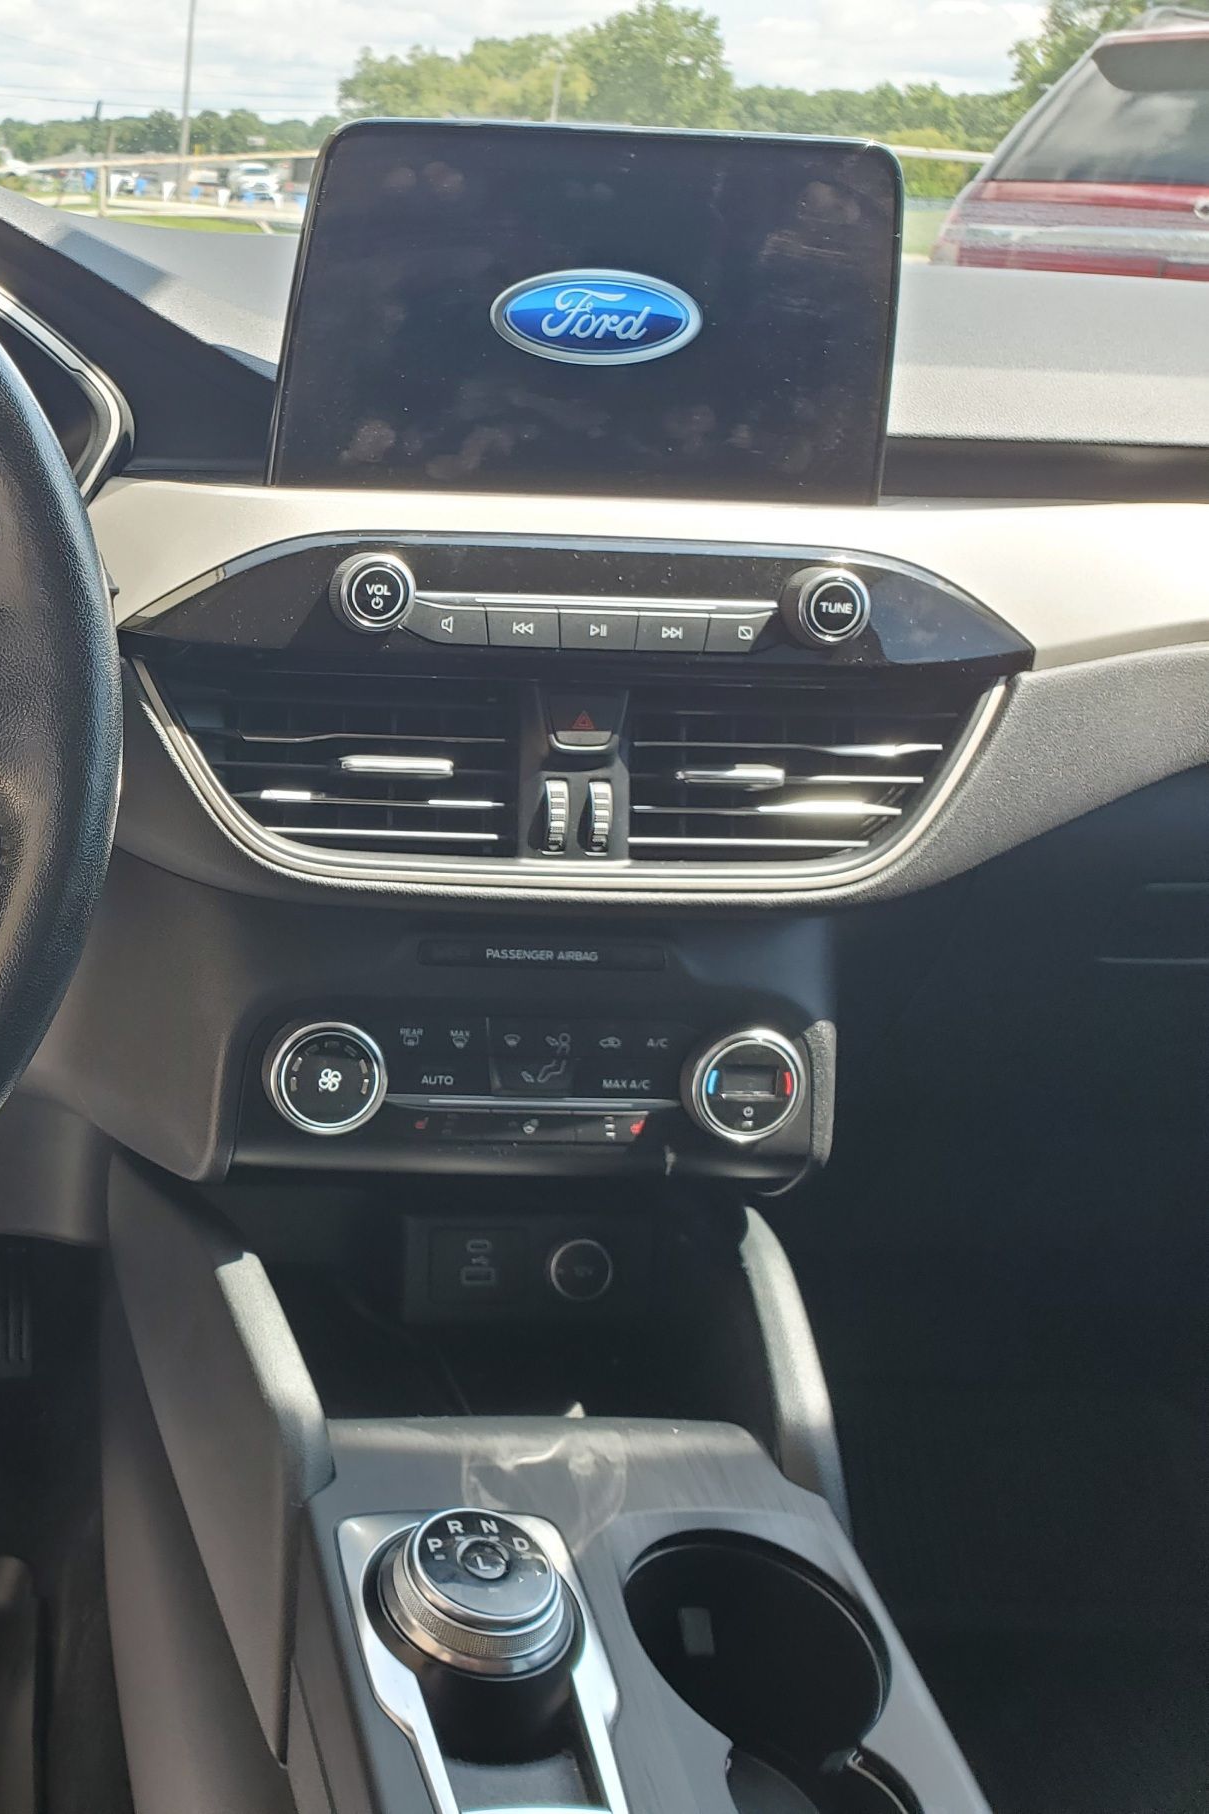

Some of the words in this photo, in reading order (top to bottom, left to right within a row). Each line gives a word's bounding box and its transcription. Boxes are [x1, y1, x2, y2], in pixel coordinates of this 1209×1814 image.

[540, 288, 652, 341] Ford
[365, 583, 391, 596] VOL
[819, 601, 853, 616] TUNE
[485, 948, 554, 960] PASSENGER
[557, 950, 599, 962] AIRBAG
[399, 1027, 424, 1037] REAR
[449, 1029, 471, 1038] MAX
[646, 1037, 669, 1049] A/C
[420, 1074, 454, 1086] AUTO
[601, 1078, 627, 1090] MAX
[628, 1078, 652, 1091] A/C
[426, 1537, 443, 1553] P
[446, 1519, 464, 1535] R
[479, 1519, 500, 1534] N
[512, 1537, 531, 1551] D
[475, 1555, 491, 1570] L
